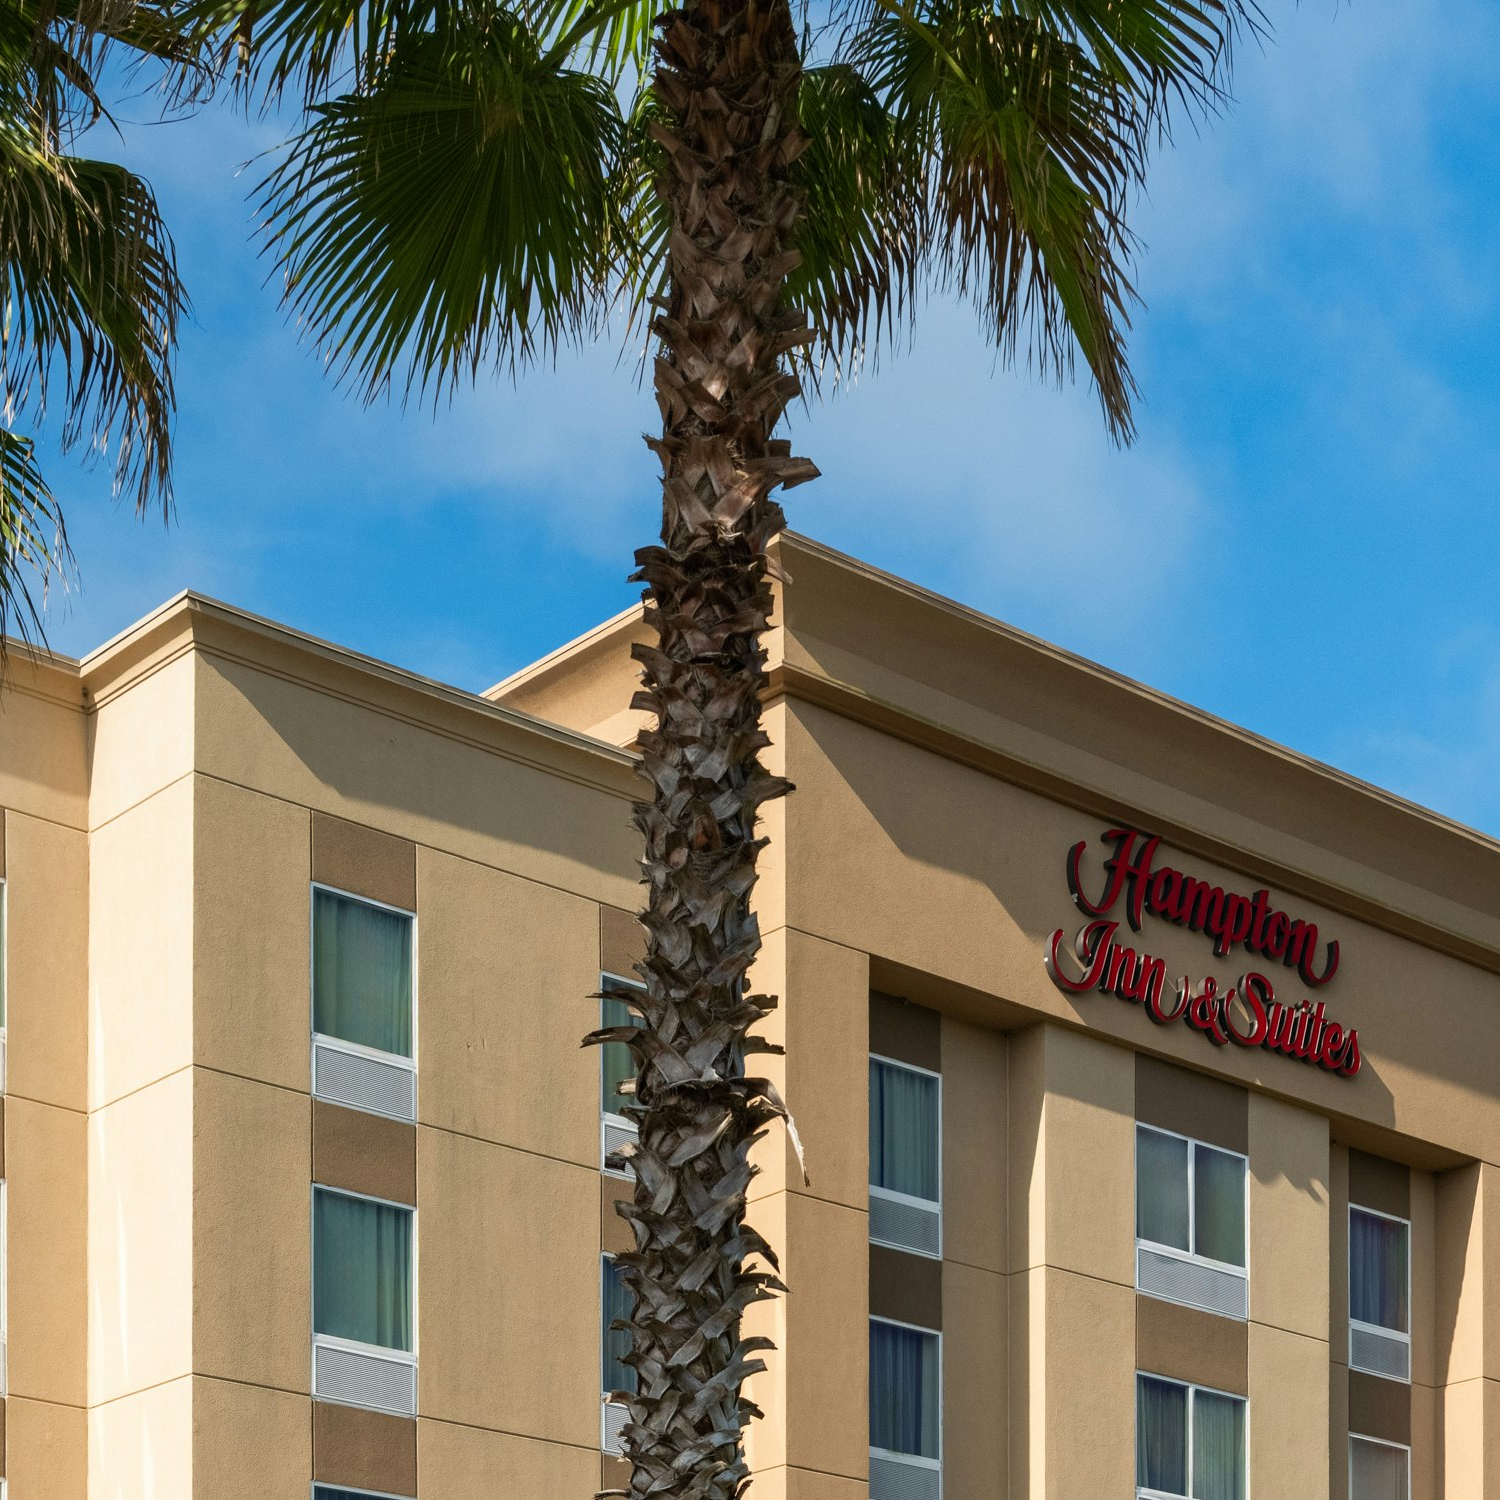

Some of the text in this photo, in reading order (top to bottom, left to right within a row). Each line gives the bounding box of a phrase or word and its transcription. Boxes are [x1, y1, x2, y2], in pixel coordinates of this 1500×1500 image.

[1066, 829, 1339, 987] Hampton
[1044, 920, 1362, 1077] Inn & Suites
